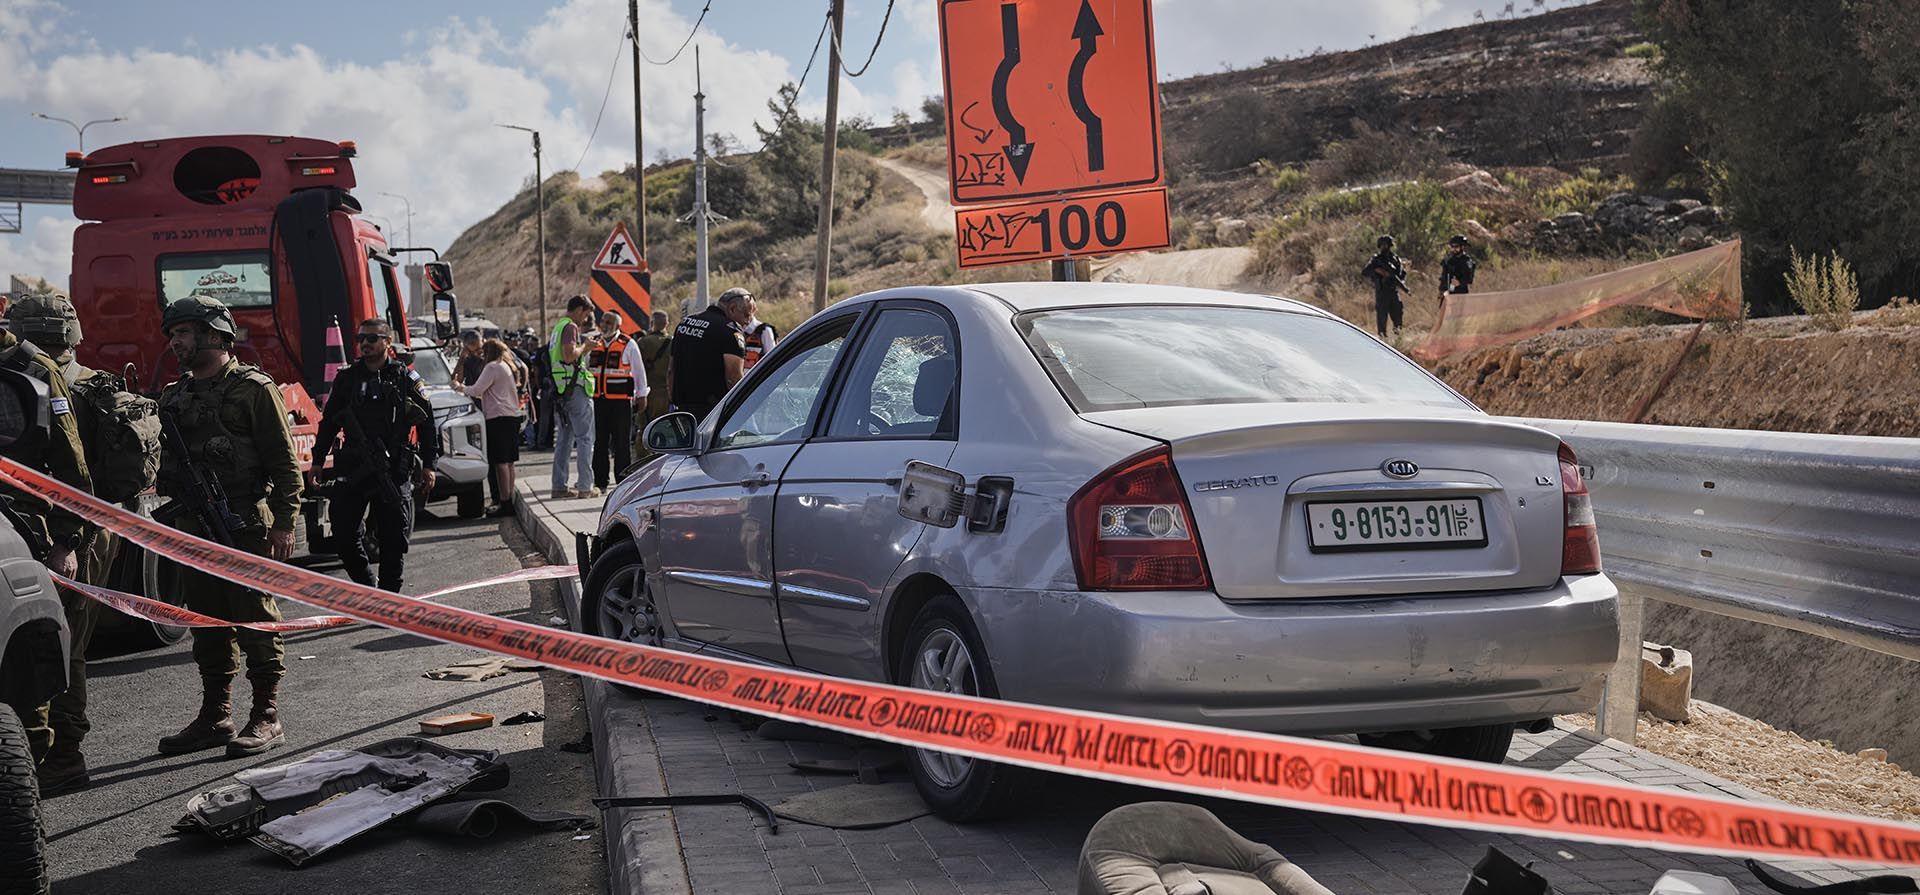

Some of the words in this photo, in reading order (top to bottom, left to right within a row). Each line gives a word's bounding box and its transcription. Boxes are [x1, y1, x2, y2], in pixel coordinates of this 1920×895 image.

[1032, 201, 1126, 253] 100
[677, 325, 704, 337] POLICE
[1391, 463, 1416, 473] KIA
[1193, 474, 1280, 492] CERATO
[1535, 476, 1554, 487] LX
[640, 660, 706, 689] משטרת
[733, 677, 790, 713] ישראל
[788, 681, 823, 711] אין
[816, 688, 868, 722] מעבר
[896, 700, 971, 738] משטרת
[1006, 720, 1067, 765] ישראל
[1073, 723, 1104, 762] אין
[1104, 731, 1160, 770] מעבר
[1199, 744, 1282, 786] משטרת
[1330, 765, 1406, 813] ישראל
[1410, 768, 1441, 809] אין
[1446, 780, 1517, 819] מעבר
[1562, 791, 1663, 834] משטרת
[1727, 818, 1824, 857] ישראל
[1831, 828, 1872, 859] אין
